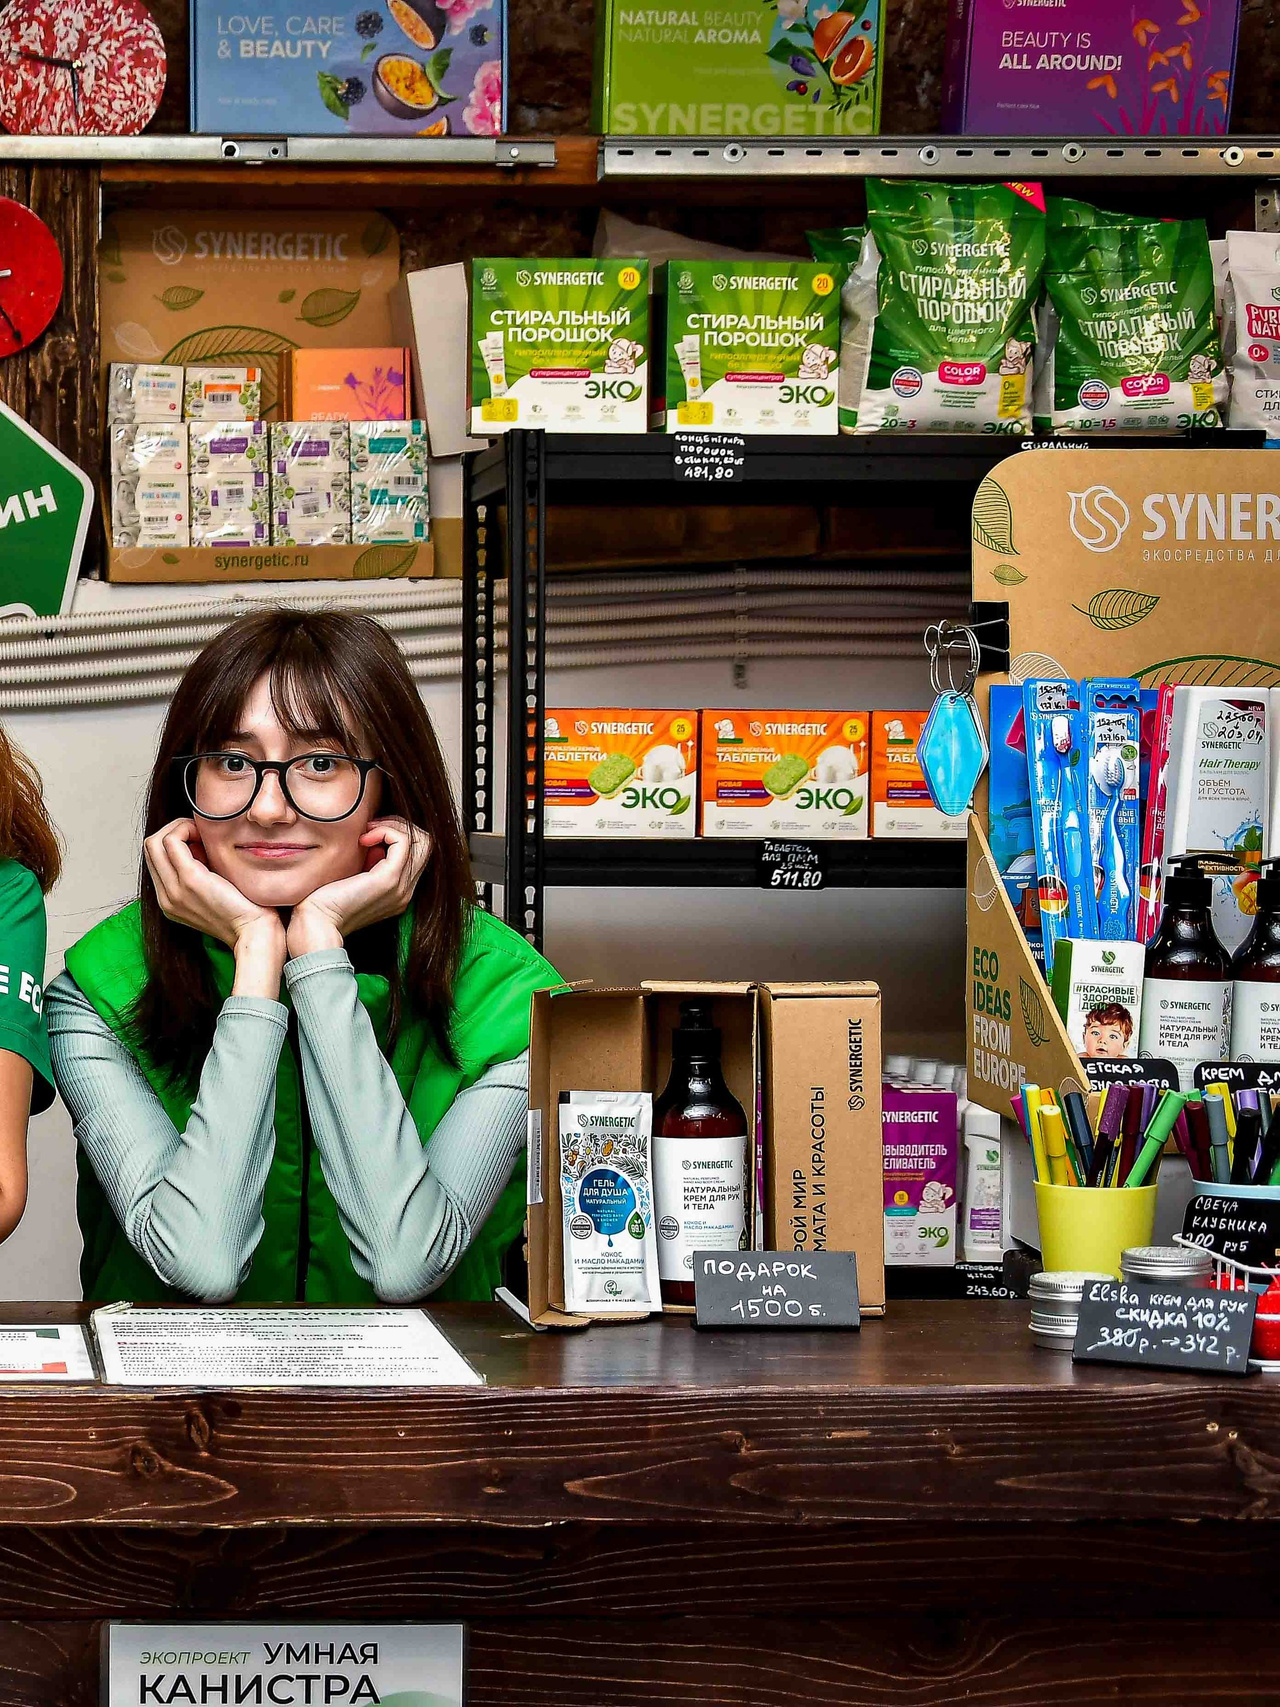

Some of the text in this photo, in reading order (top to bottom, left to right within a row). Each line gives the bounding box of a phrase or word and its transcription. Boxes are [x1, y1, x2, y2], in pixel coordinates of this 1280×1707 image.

[217, 15, 345, 37] LOVE, CARE
[620, 10, 763, 26] NATURAL BEAUTY
[618, 29, 762, 44] NATURAL AROMA
[1002, 31, 1091, 48] BEAUTY IS
[217, 40, 332, 59] & BEAUTY
[999, 53, 1122, 71] ALL AROUND!
[613, 102, 872, 136] SYNERGETIC
[194, 231, 348, 261] SYNERGETIC
[534, 271, 604, 286] SYNERGETIC
[623, 272, 635, 283] 20
[729, 275, 798, 290] SYNERGETIC
[490, 306, 631, 326] СТИРАЛЬНЫЙ
[687, 313, 824, 330] СТИРАЛЬНЫЙ
[508, 327, 614, 342] ПОРОШОК
[704, 331, 808, 347] ПОРОШОК
[944, 365, 981, 376] COLOR
[585, 381, 636, 399] ЭКО
[779, 385, 828, 404] ЭКО
[214, 551, 310, 570] synergetic.ru
[1142, 549, 1256, 563] ЭКОСРЕДСТВА
[590, 722, 654, 735] SYNERGETIC
[676, 724, 686, 732] 25
[765, 723, 828, 736] SYNERGETIC
[1201, 740, 1242, 750] SYNERGETIC
[544, 752, 607, 762] ТАБЛЕТКИ
[716, 753, 782, 763] ТАБЛЕТКИ
[1199, 758, 1261, 771] Hair Therapy
[621, 787, 681, 809] ЭКО
[795, 788, 854, 810] ЭКО
[1207, 788, 1246, 796] ГУСТОТА
[771, 870, 823, 887] 511.80
[973, 946, 999, 983] ECO
[1091, 966, 1124, 974] SYNERGETIC
[1076, 984, 1135, 996] #КРАСИВЫЕ
[973, 980, 1011, 1021] IDEAS
[1082, 993, 1136, 1004] ЗДОРОВЫЕ
[1170, 1001, 1211, 1011] SYNERGETIC
[973, 1014, 1011, 1056] FROM
[1159, 1024, 1218, 1033] НАТУРАЛЬНЫЙ
[1183, 1033, 1201, 1041] ДЛЯ
[849, 1018, 863, 1092] SYNERGETIC
[973, 1047, 1026, 1092] EUROPE
[1201, 1066, 1245, 1081] КРЕМ
[589, 1116, 636, 1128] SYNERGETIC
[693, 1160, 734, 1169] SYNERGETIC
[811, 1086, 827, 1251] МАТА И КРАСОТЫ
[593, 1179, 615, 1188] ГЕЛЬ
[684, 1183, 740, 1193] НАТУРАЛЬНЫЙ
[583, 1188, 629, 1197] ДЛЯ ДУША
[709, 1194, 726, 1202] ДЛЯ
[728, 1193, 740, 1201] РУК
[790, 1169, 808, 1251] РОЙ МИР
[1195, 1196, 1239, 1214] СВЕЧА
[1192, 1215, 1268, 1233] КЛУБНИКА
[918, 1227, 949, 1239] ЭКО
[703, 1259, 817, 1282] ПОДАРОК
[762, 1284, 787, 1297] НА
[1089, 1283, 1248, 1315] Elska КРЕМ ДЛЯ РУК
[730, 1298, 803, 1318] 1500
[1116, 1307, 1231, 1333] СКИДКА 10%
[139, 1642, 379, 1665] ЭКОПРОЕКТ УМНАЯ
[139, 1673, 381, 1705] КАНИСТРА
